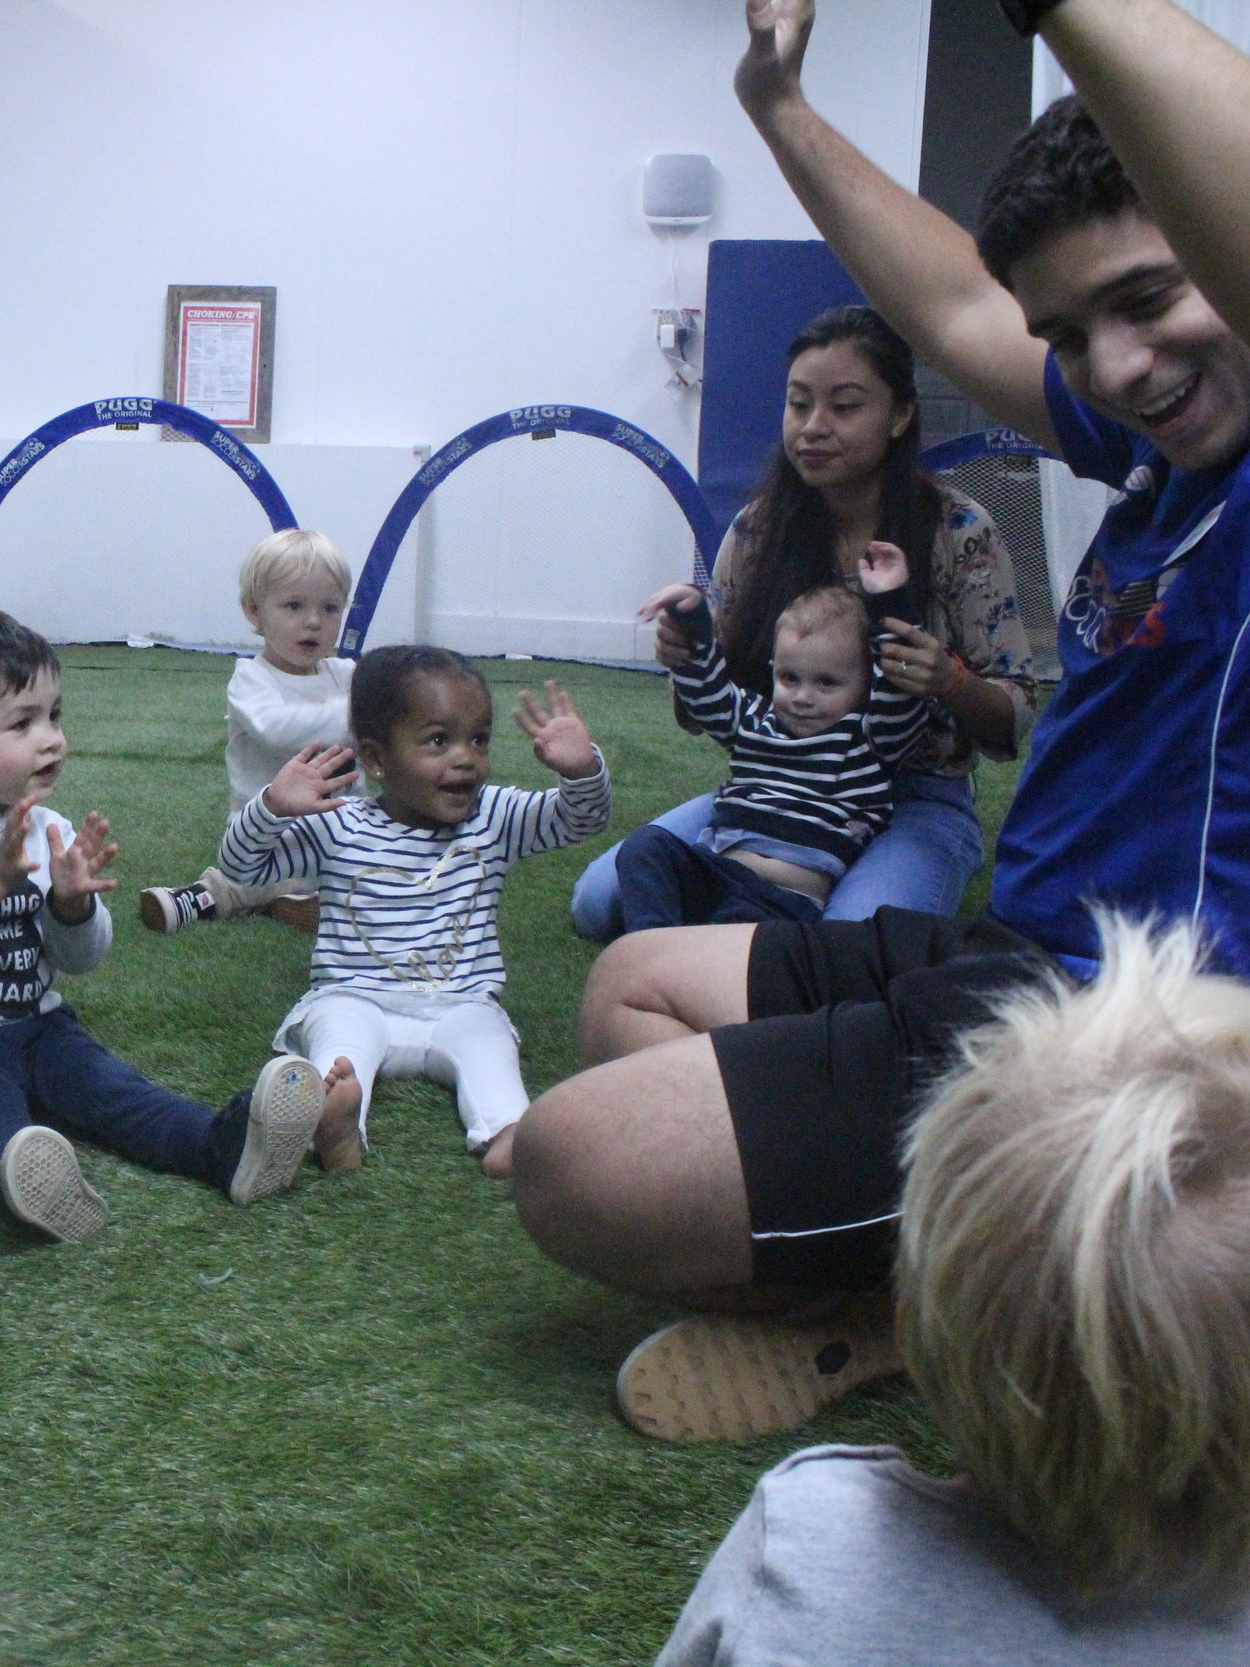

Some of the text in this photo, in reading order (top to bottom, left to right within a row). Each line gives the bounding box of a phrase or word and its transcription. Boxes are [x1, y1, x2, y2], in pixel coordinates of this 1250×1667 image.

[94, 398, 153, 415] PUGG
[509, 406, 572, 423] PUGG
[97, 410, 152, 421] THE ORIGINAL
[214, 431, 240, 453] SUPER
[0, 893, 41, 917] HUG
